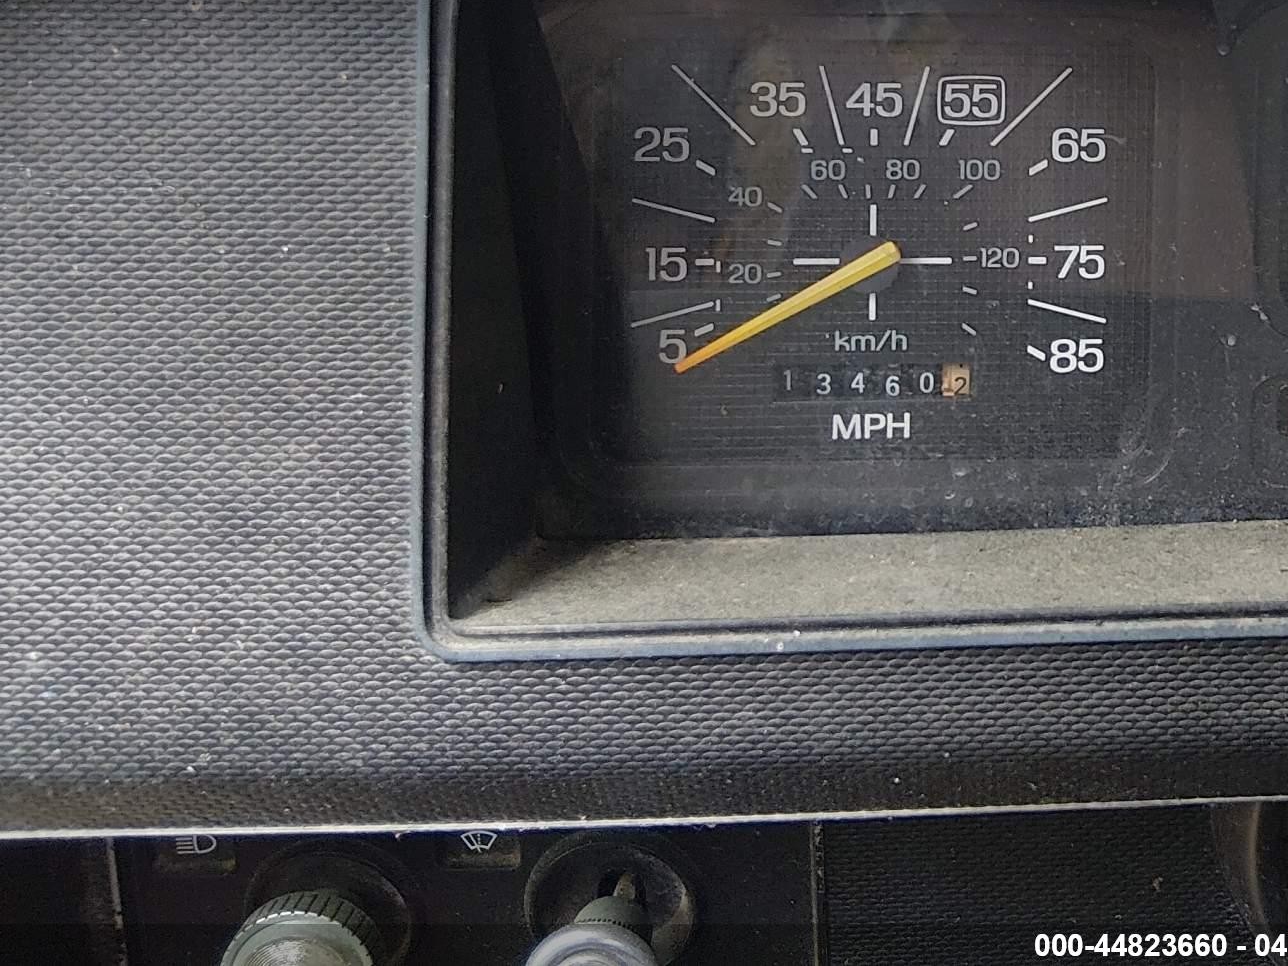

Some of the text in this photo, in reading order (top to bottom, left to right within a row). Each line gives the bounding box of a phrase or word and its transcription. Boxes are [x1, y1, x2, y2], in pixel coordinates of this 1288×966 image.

[749, 81, 806, 117] 35
[845, 82, 903, 118] 45
[943, 83, 999, 118] 55
[634, 126, 690, 163] 25
[1051, 127, 1106, 163] 65
[810, 159, 846, 181] 60
[885, 159, 920, 180] 80
[958, 159, 1001, 181] 100
[728, 185, 763, 208] 40
[645, 247, 688, 281] 15
[727, 263, 762, 284] 20
[979, 247, 1020, 268] 120
[1053, 245, 1105, 279] 75
[658, 329, 687, 365] 5
[834, 329, 908, 352] km/h
[1049, 338, 1104, 374] 85
[831, 412, 911, 440] MPH
